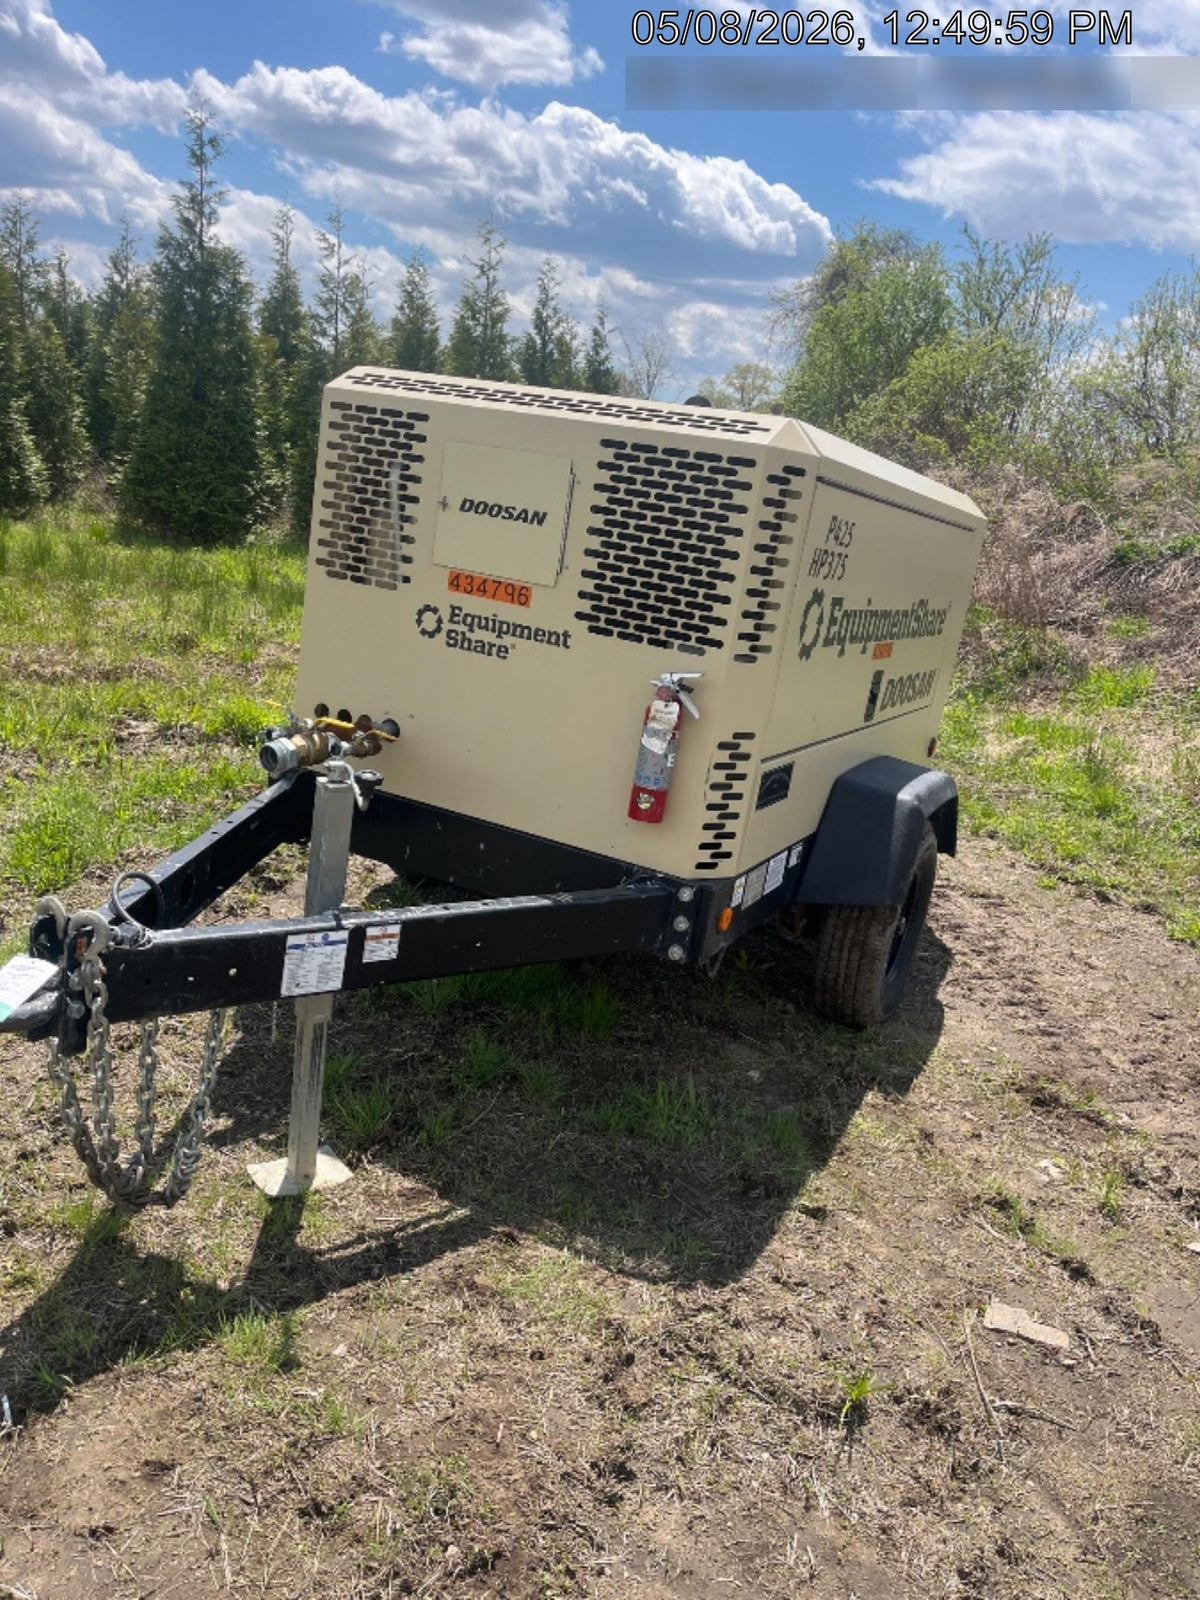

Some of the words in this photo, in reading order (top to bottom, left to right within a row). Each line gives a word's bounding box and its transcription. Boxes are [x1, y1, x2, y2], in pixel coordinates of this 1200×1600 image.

[458, 498, 547, 527] DOOSAN
[825, 515, 856, 549] P425
[808, 547, 849, 581] HP375
[449, 574, 530, 606] 434796
[447, 604, 571, 649] Equipment
[822, 597, 947, 657] EquipmentShare
[445, 628, 510, 660] Share
[879, 668, 937, 712] DOOSAN
